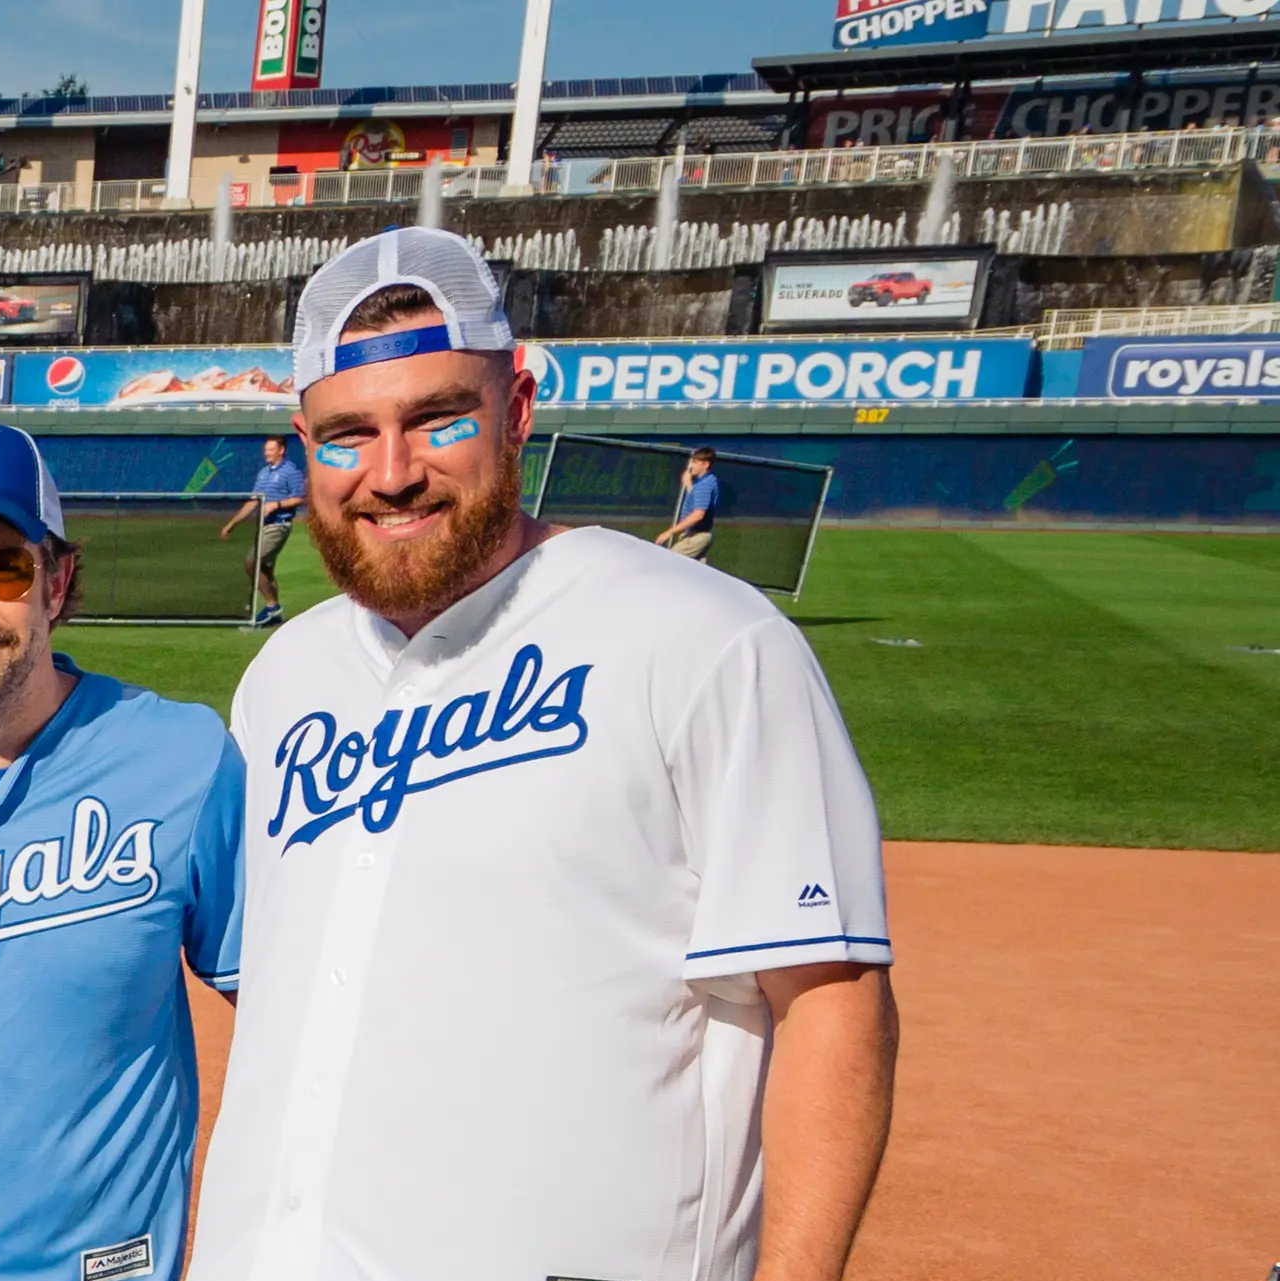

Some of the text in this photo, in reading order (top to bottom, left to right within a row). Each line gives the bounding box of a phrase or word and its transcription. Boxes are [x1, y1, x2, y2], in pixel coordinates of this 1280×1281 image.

[839, 0, 988, 46] CHOPPER
[778, 290, 843, 299] SILVERADO
[575, 350, 982, 400] PEPSI PORCH
[855, 408, 889, 423] 387
[268, 644, 594, 857] Royals
[106, 1249, 143, 1266] Majestic
